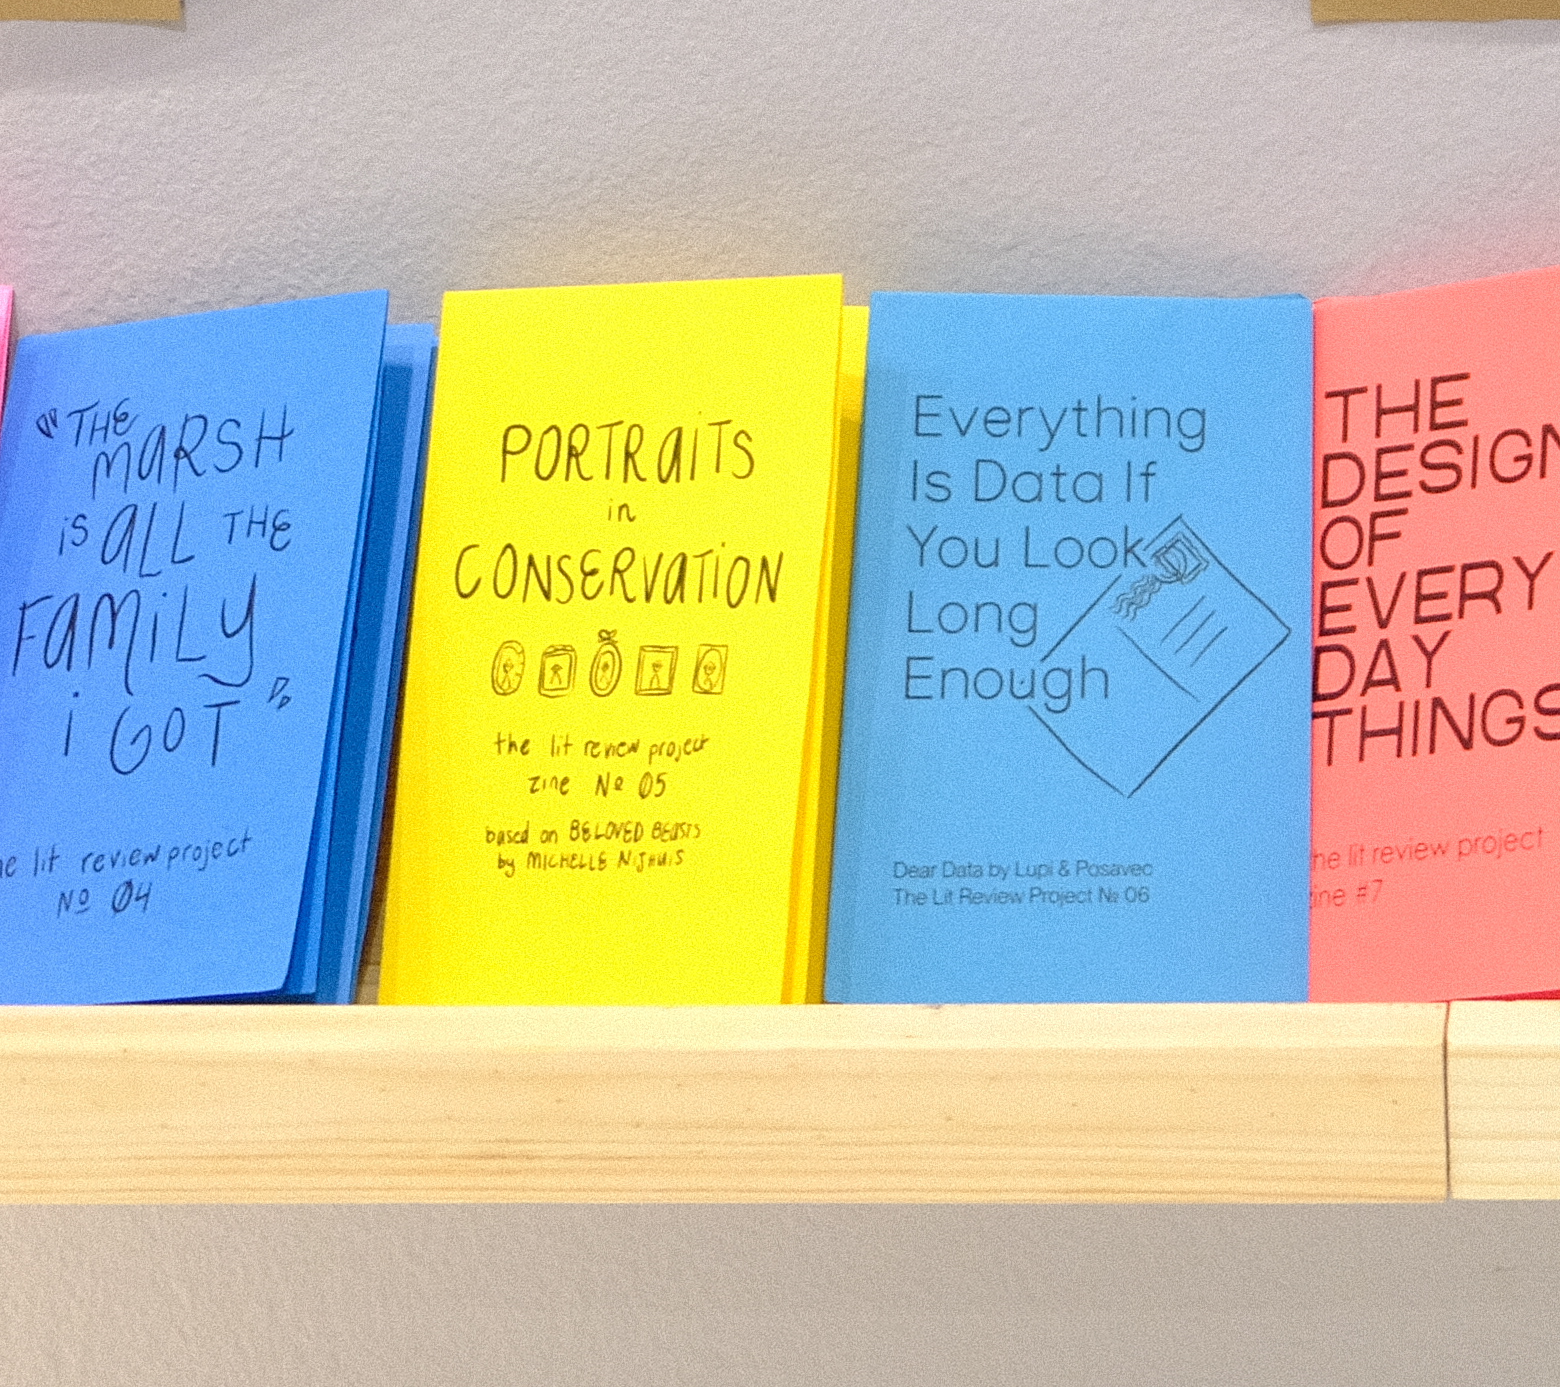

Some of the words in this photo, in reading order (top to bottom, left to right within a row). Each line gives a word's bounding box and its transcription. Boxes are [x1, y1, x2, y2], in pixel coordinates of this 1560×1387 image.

[913, 394, 1208, 452] Everything
[1325, 372, 1470, 444] THE
[911, 459, 952, 504] Is
[973, 459, 1104, 504] Data
[1124, 461, 1158, 504] If
[608, 499, 635, 522] in
[906, 526, 1000, 569] You
[1023, 526, 1146, 569] Look
[1320, 507, 1409, 571] OF
[906, 592, 1039, 647] Long
[905, 657, 1111, 713] Enough
[1313, 630, 1451, 703] DAY
[34, 848, 62, 877] lit
[80, 845, 161, 872] review
[168, 831, 253, 870] project
[893, 861, 937, 879] Dear
[942, 860, 983, 879] Data
[989, 861, 1009, 881] by
[1013, 860, 1054, 881] Lupi
[1058, 861, 1070, 877] &
[1075, 860, 1153, 878] Posavec
